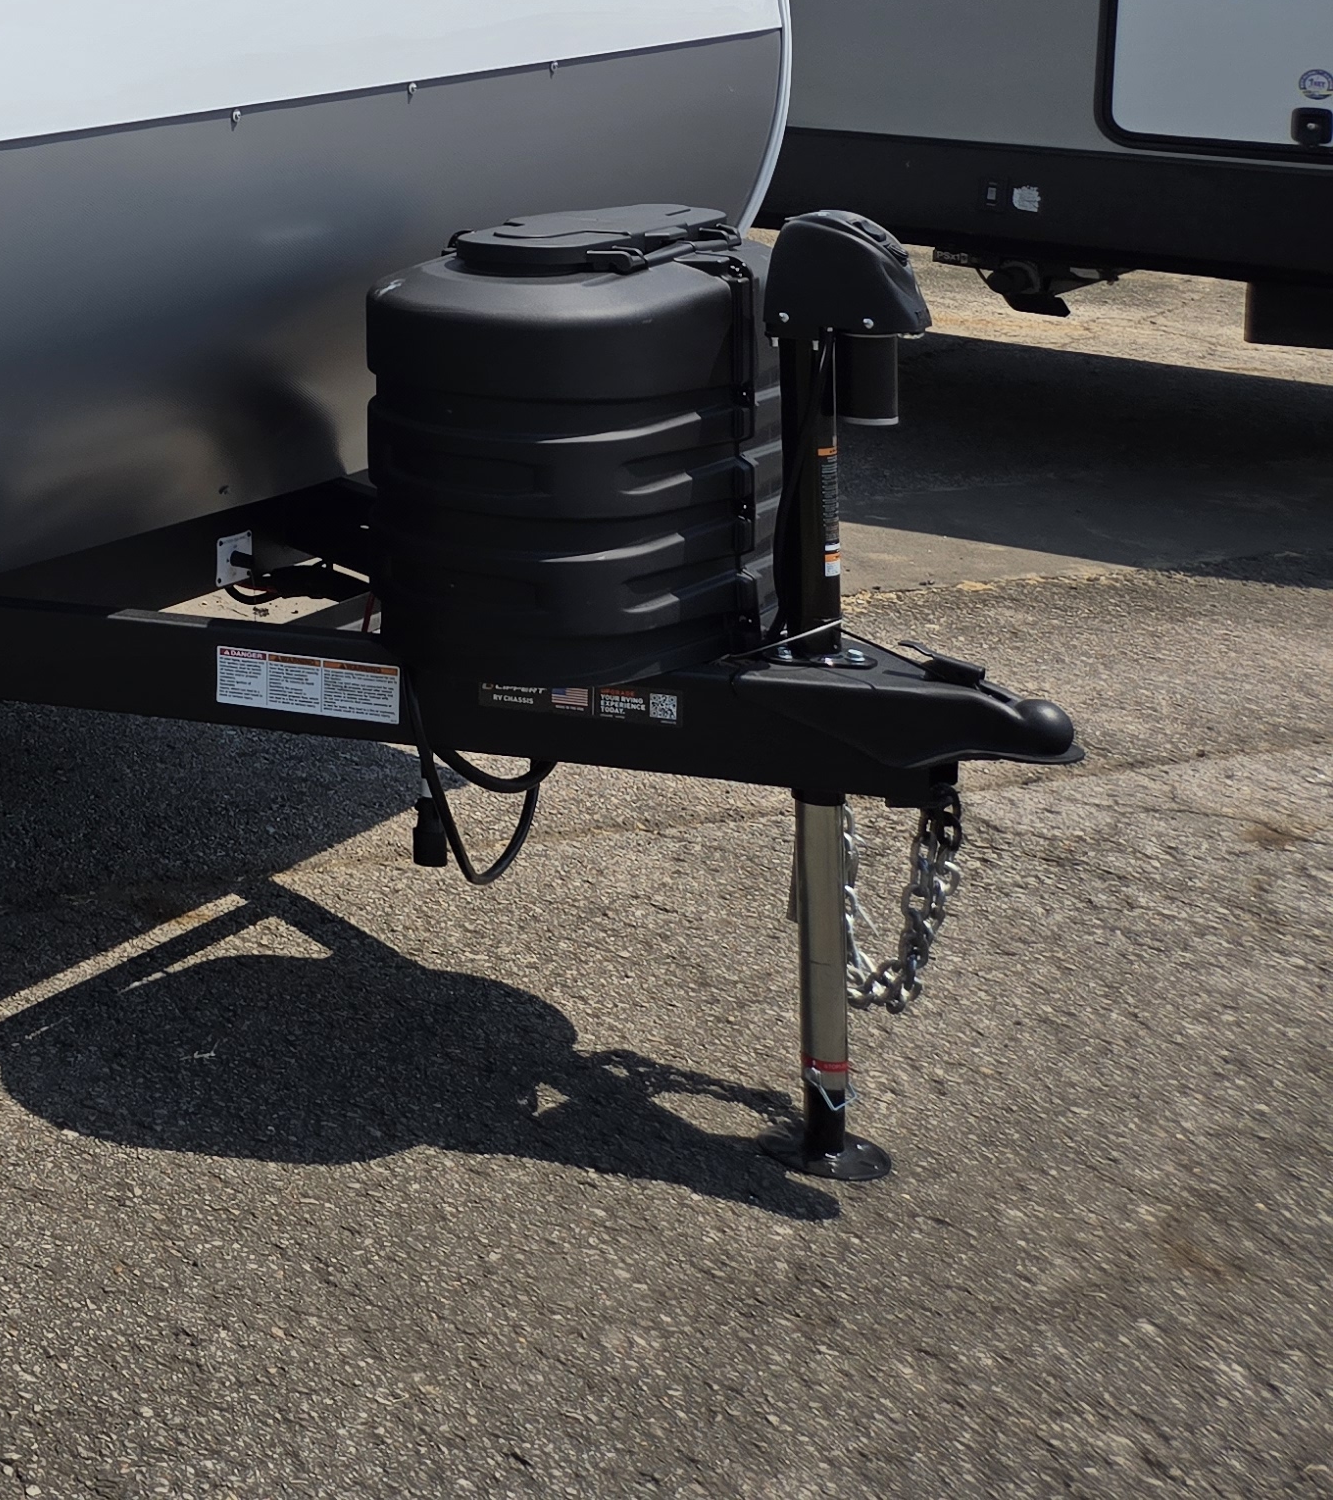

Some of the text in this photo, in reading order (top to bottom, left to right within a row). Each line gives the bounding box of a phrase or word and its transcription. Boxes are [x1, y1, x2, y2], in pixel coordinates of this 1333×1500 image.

[231, 649, 263, 659] DANGER
[493, 693, 534, 704] RV CHASSIS
[600, 694, 620, 702] YOUR
[600, 700, 646, 711] EXPERIENCE
